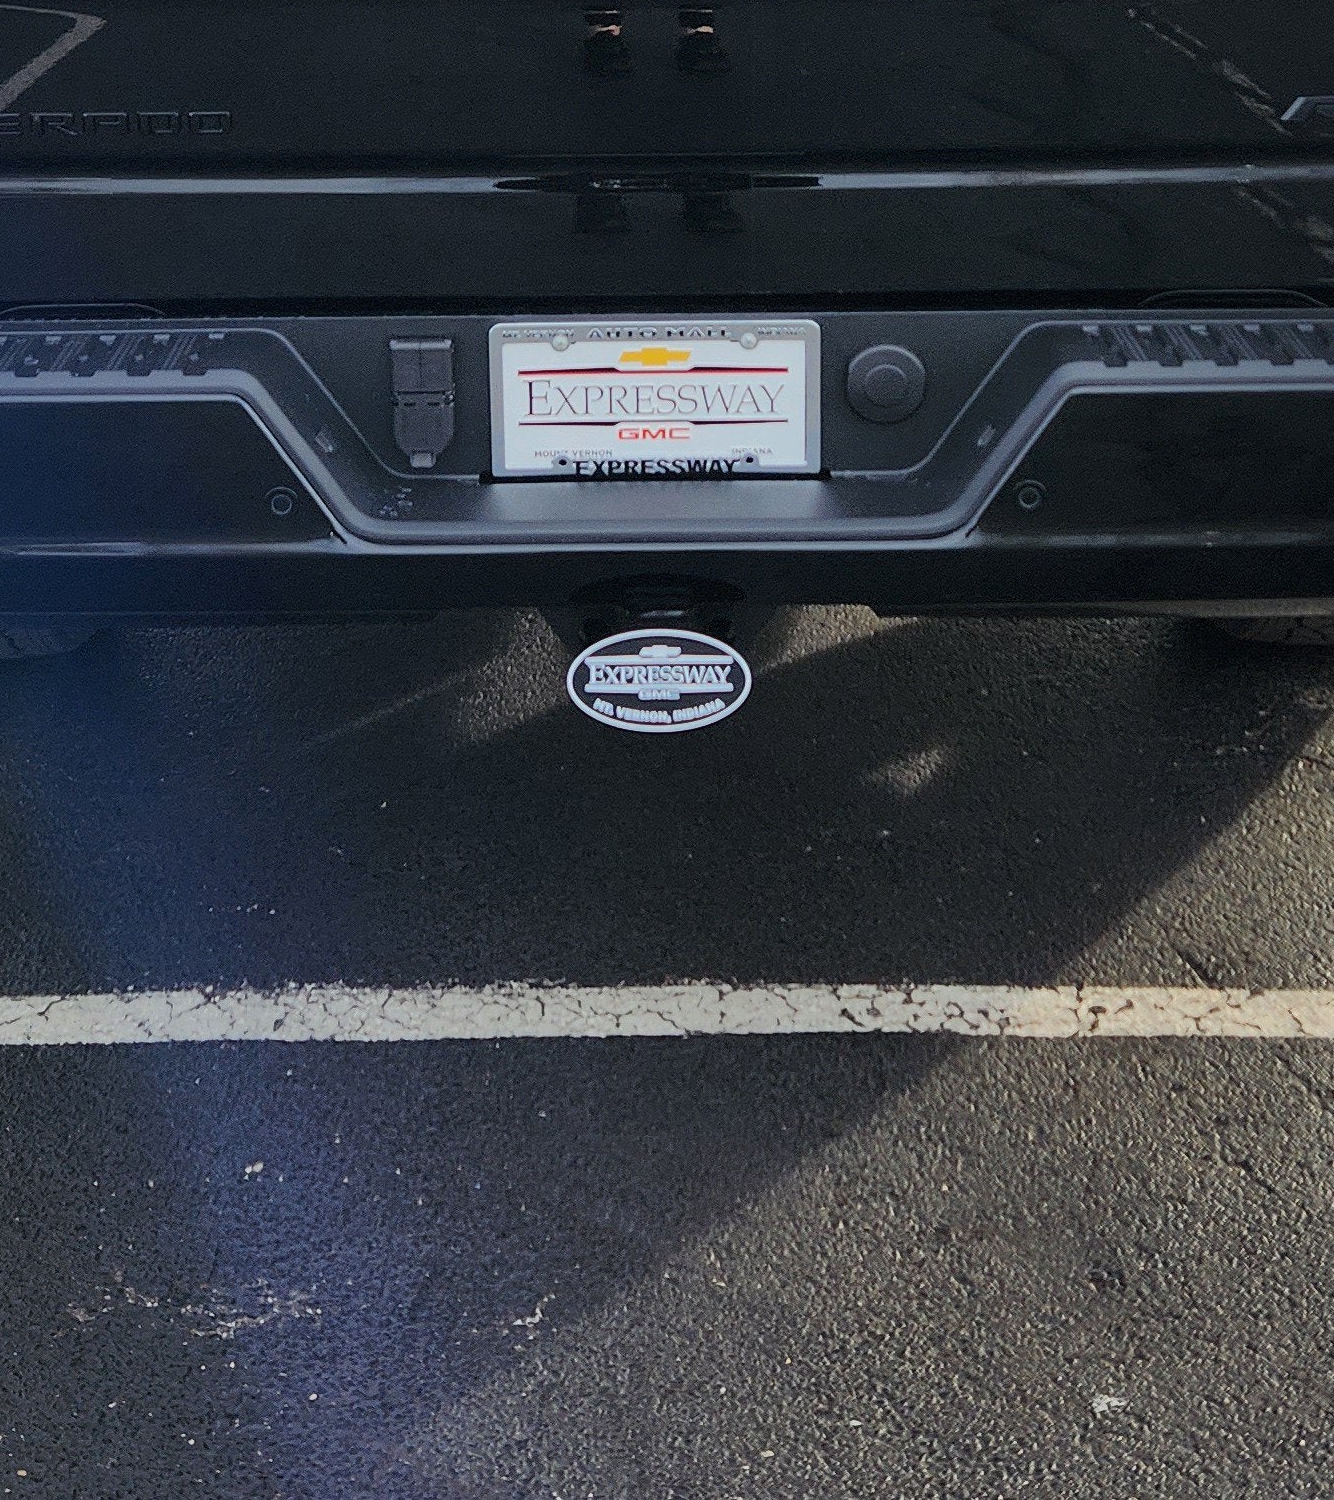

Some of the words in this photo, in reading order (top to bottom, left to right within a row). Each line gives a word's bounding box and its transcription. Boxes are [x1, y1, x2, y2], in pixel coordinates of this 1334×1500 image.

[586, 326, 658, 339] AUTO
[665, 326, 733, 338] MALL
[617, 427, 691, 440] GMC
[572, 448, 613, 457] VERNON
[731, 446, 774, 455] INANA
[573, 458, 741, 477] EXPRESSWAY
[588, 664, 732, 685] EXPRESSWAY
[672, 698, 726, 721] INDIANA
